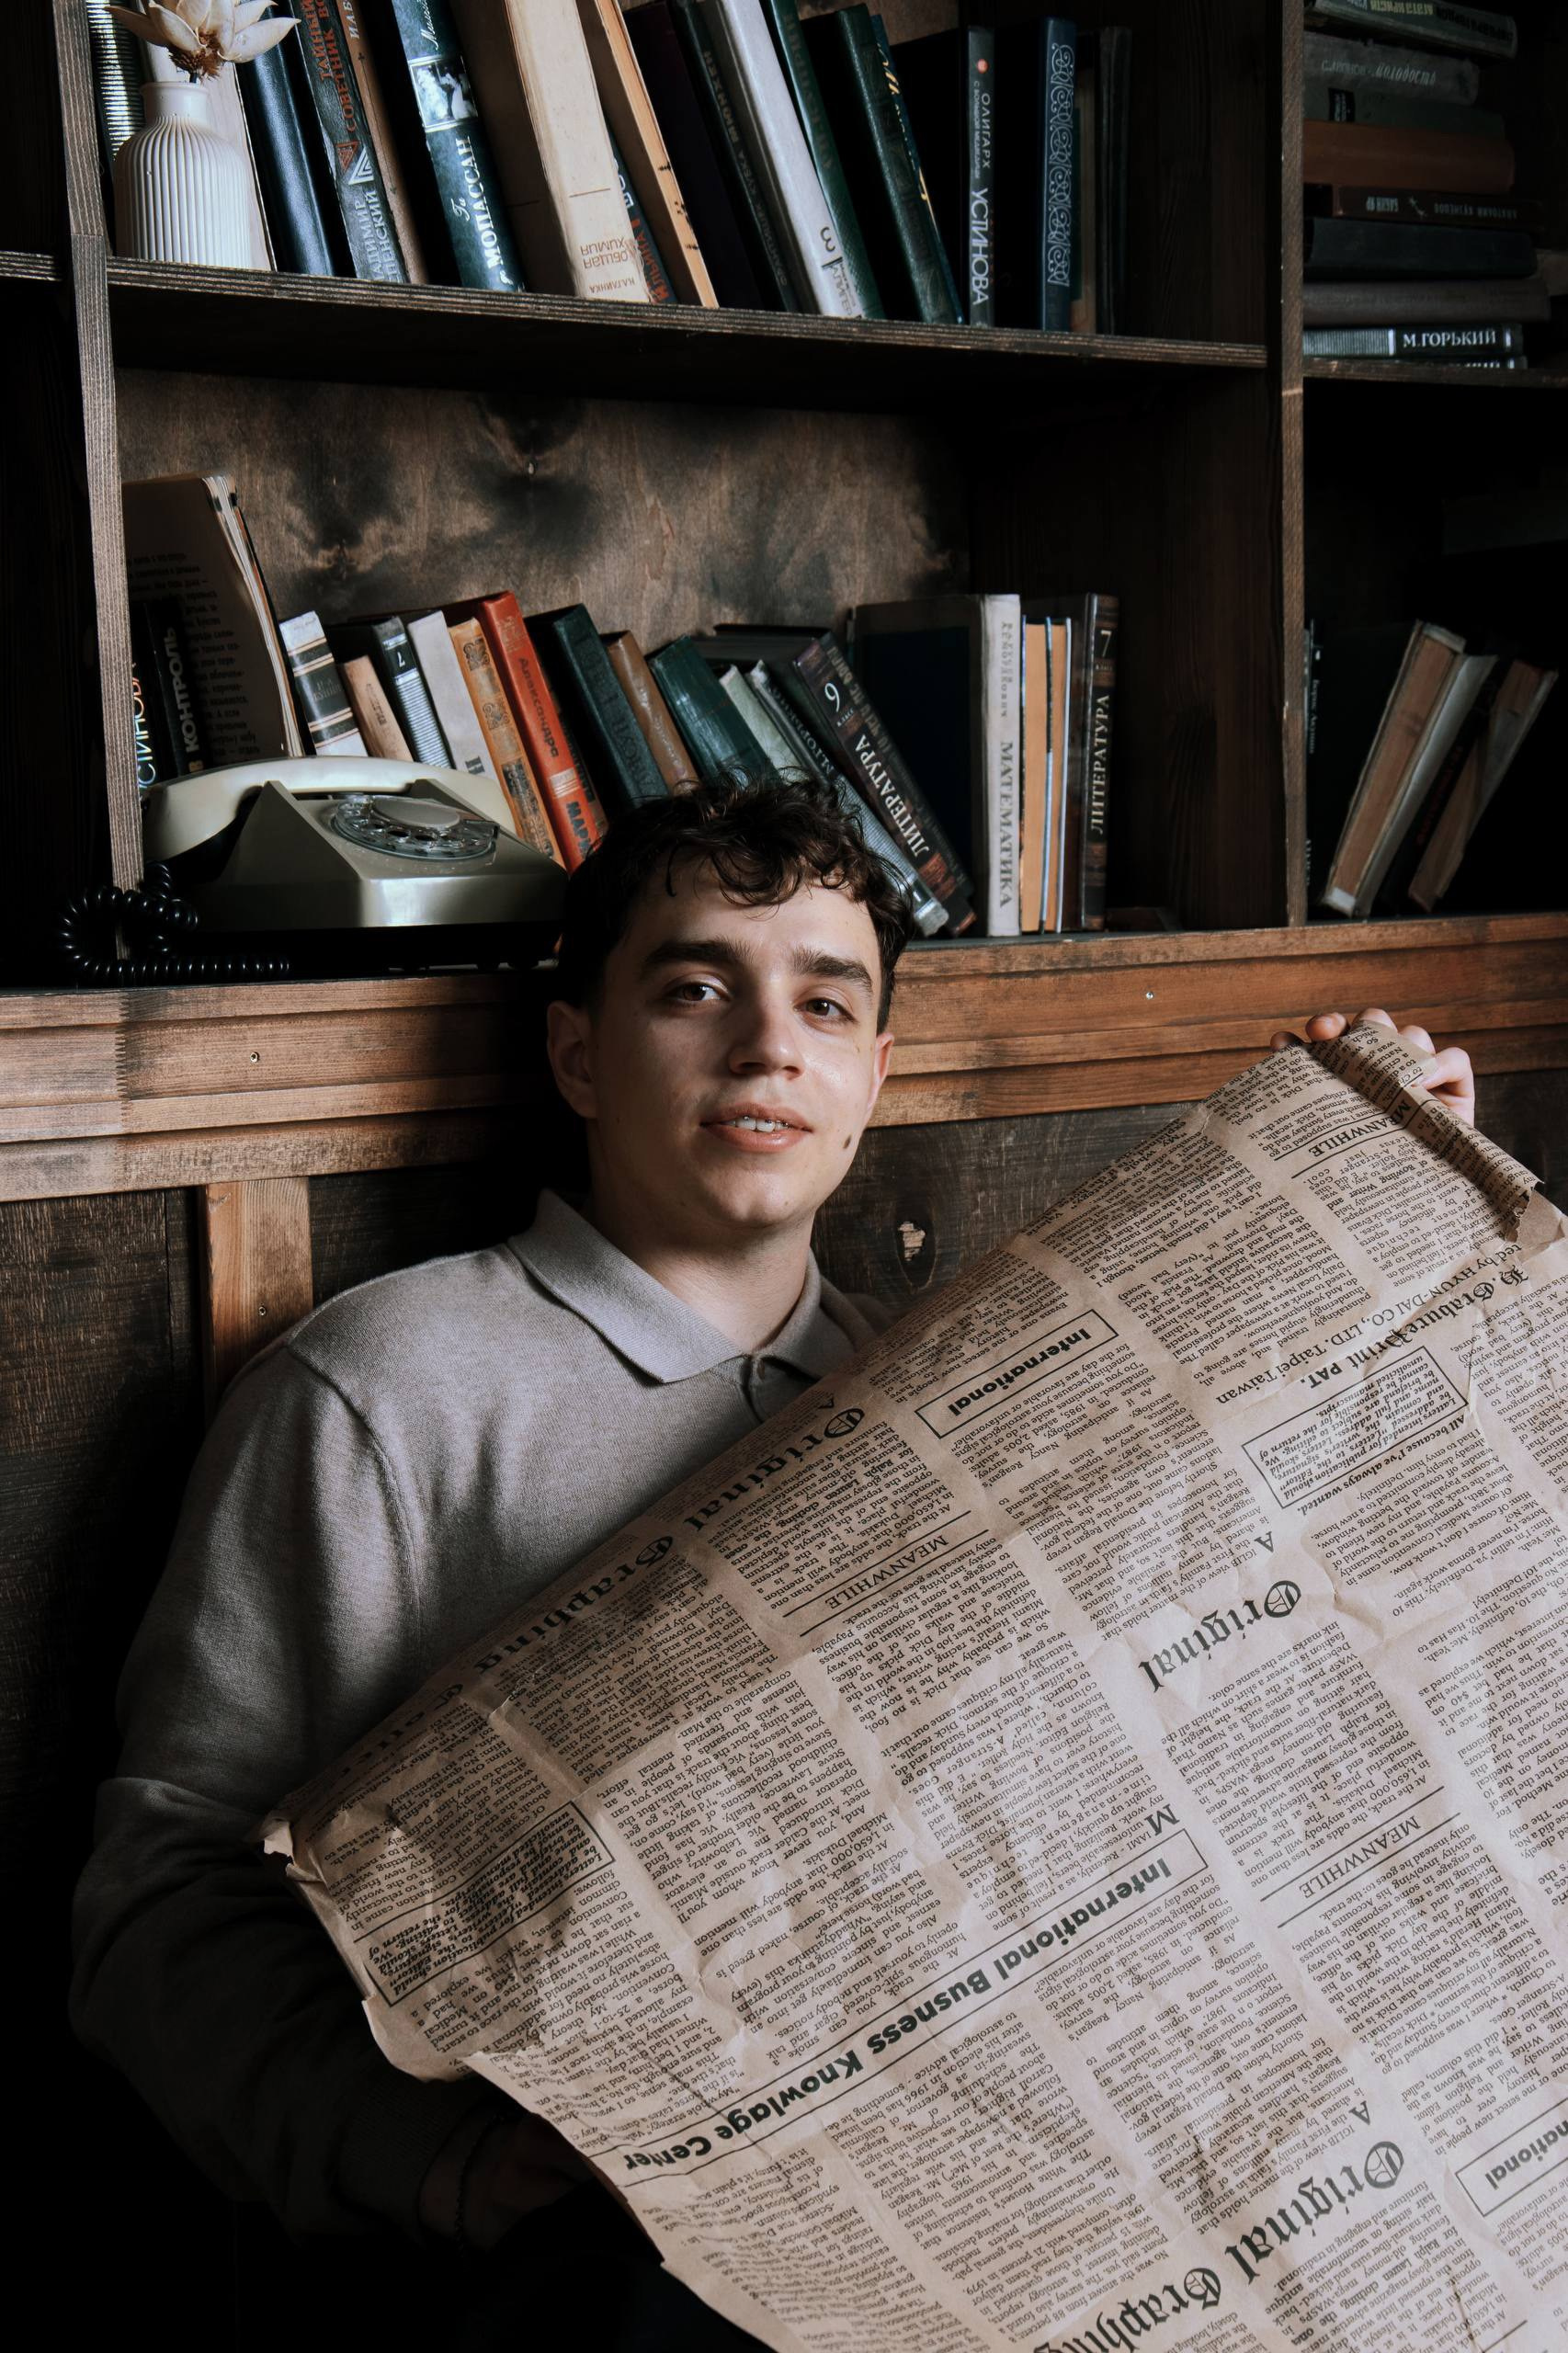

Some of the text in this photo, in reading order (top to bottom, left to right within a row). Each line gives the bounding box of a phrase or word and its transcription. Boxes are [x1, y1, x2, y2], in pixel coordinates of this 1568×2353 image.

[324, 28, 358, 132] СОВЕТНИК
[981, 92, 991, 169] ОЛИГАРХ
[355, 200, 384, 280] АДИМИР
[364, 190, 403, 283] СПЕНСКИЙ
[456, 136, 503, 269] МОПАССАН
[818, 225, 837, 253] 3
[971, 187, 989, 305] УСТИНОВА
[1403, 330, 1497, 348] М.ГОРЬКИЙ
[1100, 629, 1112, 657] 7
[163, 625, 200, 752] КОНТРОЛЬ
[518, 658, 559, 758] Александра
[824, 683, 840, 712] 9
[855, 734, 930, 857] ЛИТЕРАТУРА
[1090, 694, 1111, 835] ЛИТЕРАТУРА
[1000, 741, 1014, 908] МАТЕМАТИКА
[1308, 1105, 1410, 1157] MEANWHILE
[1394, 1266, 1478, 1315] HYUN-DAI
[948, 1328, 1092, 1416] International
[1199, 1291, 1371, 1386] painstakingly trained and, above all,
[1275, 1343, 1327, 1377] Taipei
[1300, 1362, 1343, 1389] PAT.
[1216, 1369, 1278, 1404] Taiwan
[1315, 1355, 1423, 1417] unsolicited manuscripts.
[974, 1374, 1156, 1479] reliance on astrology, the survey,
[1297, 1414, 1464, 1515] All because I've always wanted.
[683, 1408, 865, 1530] Original
[824, 1534, 949, 1609] MEANWHILE
[1179, 1583, 1196, 1595] the
[1196, 1576, 1206, 1589] of
[1208, 1564, 1230, 1580] view
[1230, 1548, 1257, 1567] IGLIB
[1101, 1625, 1122, 1641] that
[1122, 1610, 1150, 1628] holds
[1138, 1580, 1301, 1693] Original
[1148, 1592, 1179, 1613] matter
[596, 1679, 799, 1799] intense and frenzied mental effort,
[1382, 1749, 1424, 1779] Michael
[657, 1768, 857, 1890] operator named Vic Leibowitz, who
[959, 1763, 1144, 1879] recommended by efficiency experts
[1303, 1811, 1325, 1826] The
[1332, 1779, 1375, 1806] Dukakis.
[1253, 1848, 1264, 1857] is
[1270, 1829, 1295, 1847] track
[1299, 1815, 1421, 1898] MEANWHILE
[1336, 1895, 1517, 2014] Miami Herald's racing writer, which is
[623, 1858, 1171, 2177] International Busness Knowlage Center
[848, 2042, 1040, 2160] The scheduling of Mr. Reagan's
[1174, 2076, 1355, 2202] Americans. But the available evidence
[904, 2117, 1087, 2230] speeches and announcements invites
[1485, 2120, 1568, 2191] national
[1224, 2141, 1404, 2285] Original
